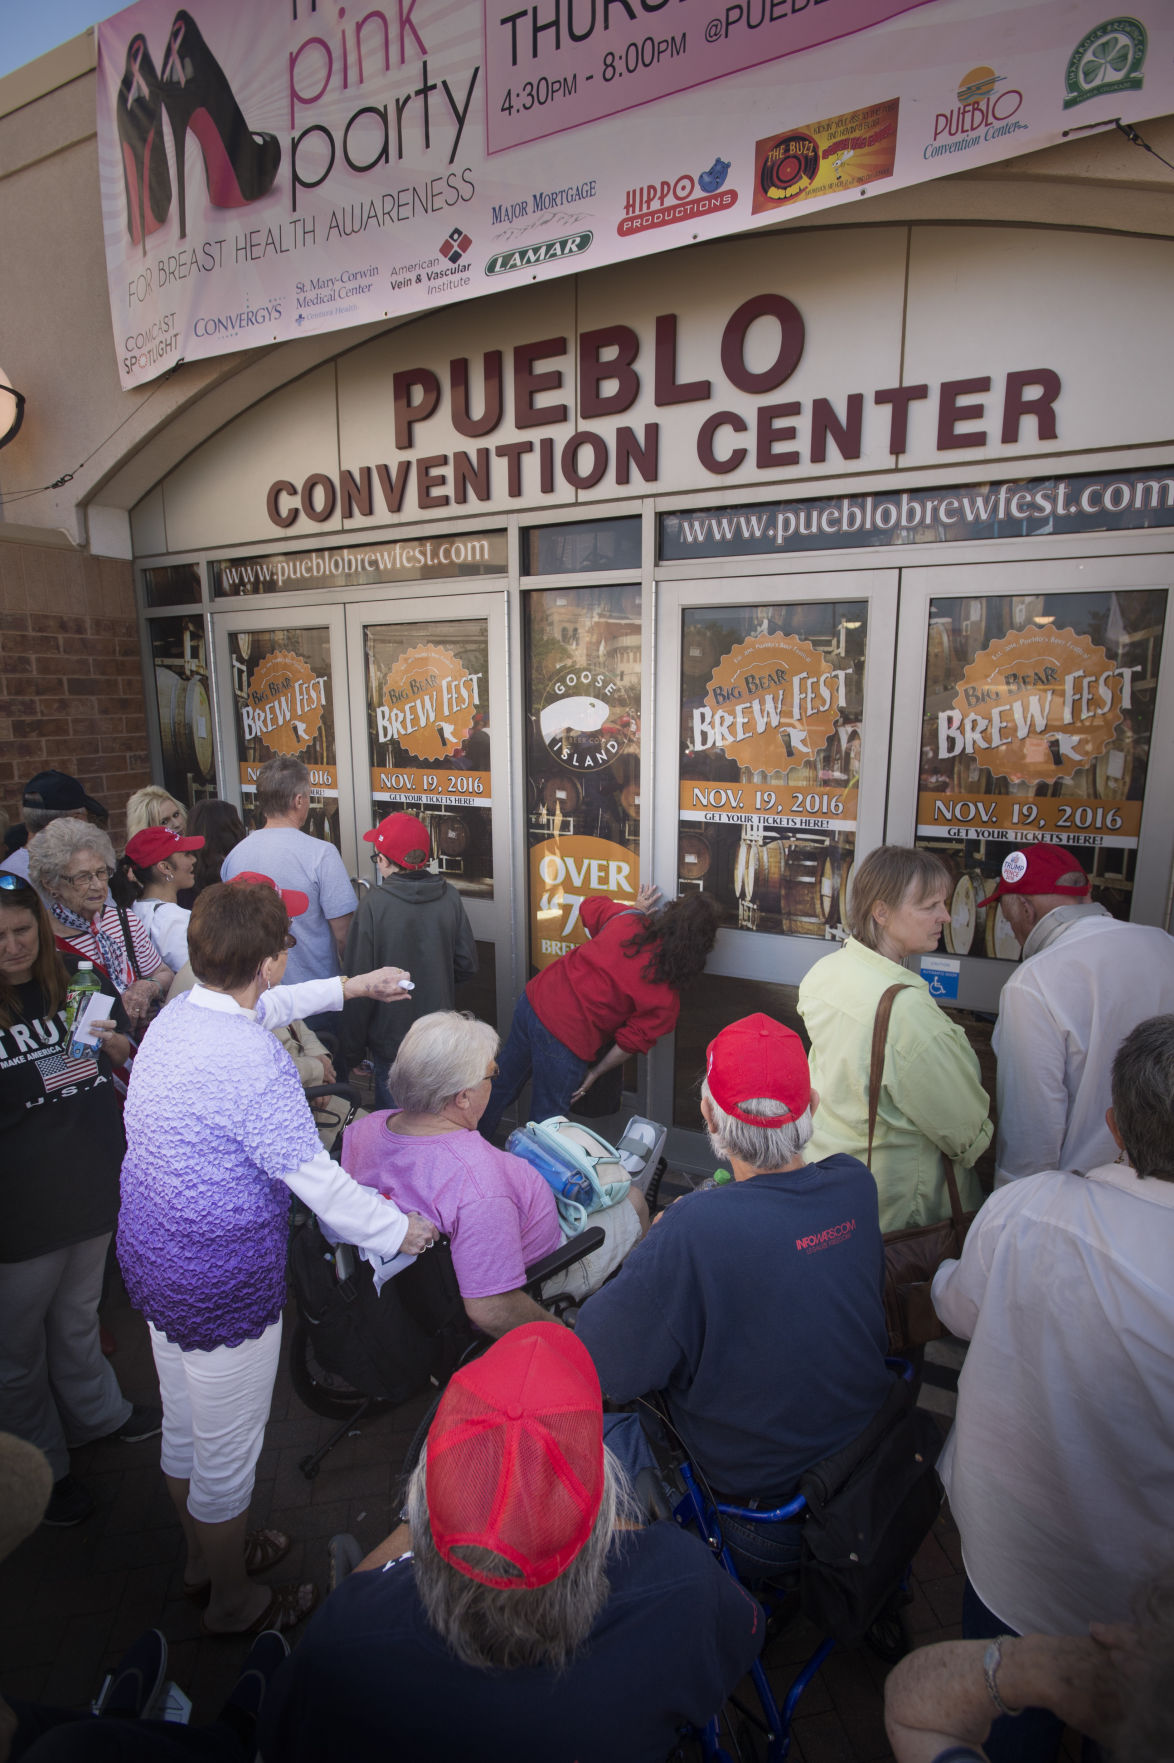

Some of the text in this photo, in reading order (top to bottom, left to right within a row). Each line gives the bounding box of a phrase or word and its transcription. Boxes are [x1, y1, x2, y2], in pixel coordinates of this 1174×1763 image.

[289, 0, 428, 130] pink
[934, 90, 1022, 141] PUEBLO
[290, 60, 481, 212] party
[767, 143, 786, 165] THE
[789, 139, 816, 157] BUZZ
[923, 134, 981, 160] Convention
[985, 121, 1021, 142] Center
[491, 180, 597, 225] MAJOR MORTGAGE
[622, 194, 733, 231] PRODUCTIONS
[624, 174, 696, 216] HIPPO
[128, 168, 475, 308] FOR BREAST HEALTH AWARENESS
[494, 235, 581, 273] LAMAR
[295, 265, 379, 295] St. Mary-Corwin
[390, 258, 440, 277] American
[390, 262, 472, 291] Vein & Vascular
[427, 275, 471, 295] Institute
[296, 282, 373, 309] Medical Center
[125, 312, 177, 352] COMCAST
[194, 304, 283, 338] CONVERGYS
[123, 333, 181, 375] SPOTLIGHT
[393, 293, 805, 450] PUEBLO
[266, 367, 1062, 529] CONVENTION CENTER
[679, 475, 1174, 547] www.pueblobrewfest.com
[224, 540, 489, 586] www.pueblobrewfest.com
[251, 677, 292, 706] BIG BEAR
[388, 674, 439, 705] BIG BEAR
[554, 671, 617, 696] GOOSE
[712, 667, 790, 706] BIG BEAR
[963, 665, 1060, 708] BIG BEAR
[242, 676, 328, 740] BREW FEST
[376, 672, 483, 743] BREW FEST
[692, 668, 853, 752] BREW FEST
[938, 665, 1142, 760] BREW FEST
[553, 741, 618, 768] ISLAND
[310, 769, 332, 786] 016
[380, 773, 484, 794] NOV. 19, 2016
[389, 793, 475, 806] GET YOUR TICKETS HERE!
[692, 786, 845, 816] NOV. 19, 2016
[934, 799, 1123, 831] NOV. 19, 2016
[704, 811, 830, 829] GET YOUR TICKETS HERE!
[947, 827, 1104, 846] GET YOUR TICKETS HERE!
[539, 855, 635, 893] OVER
[1005, 861, 1025, 871] TRUMP
[0, 1010, 68, 1060] TRU
[0, 1056, 28, 1070] MAKE
[27, 1044, 62, 1061] AMERICA
